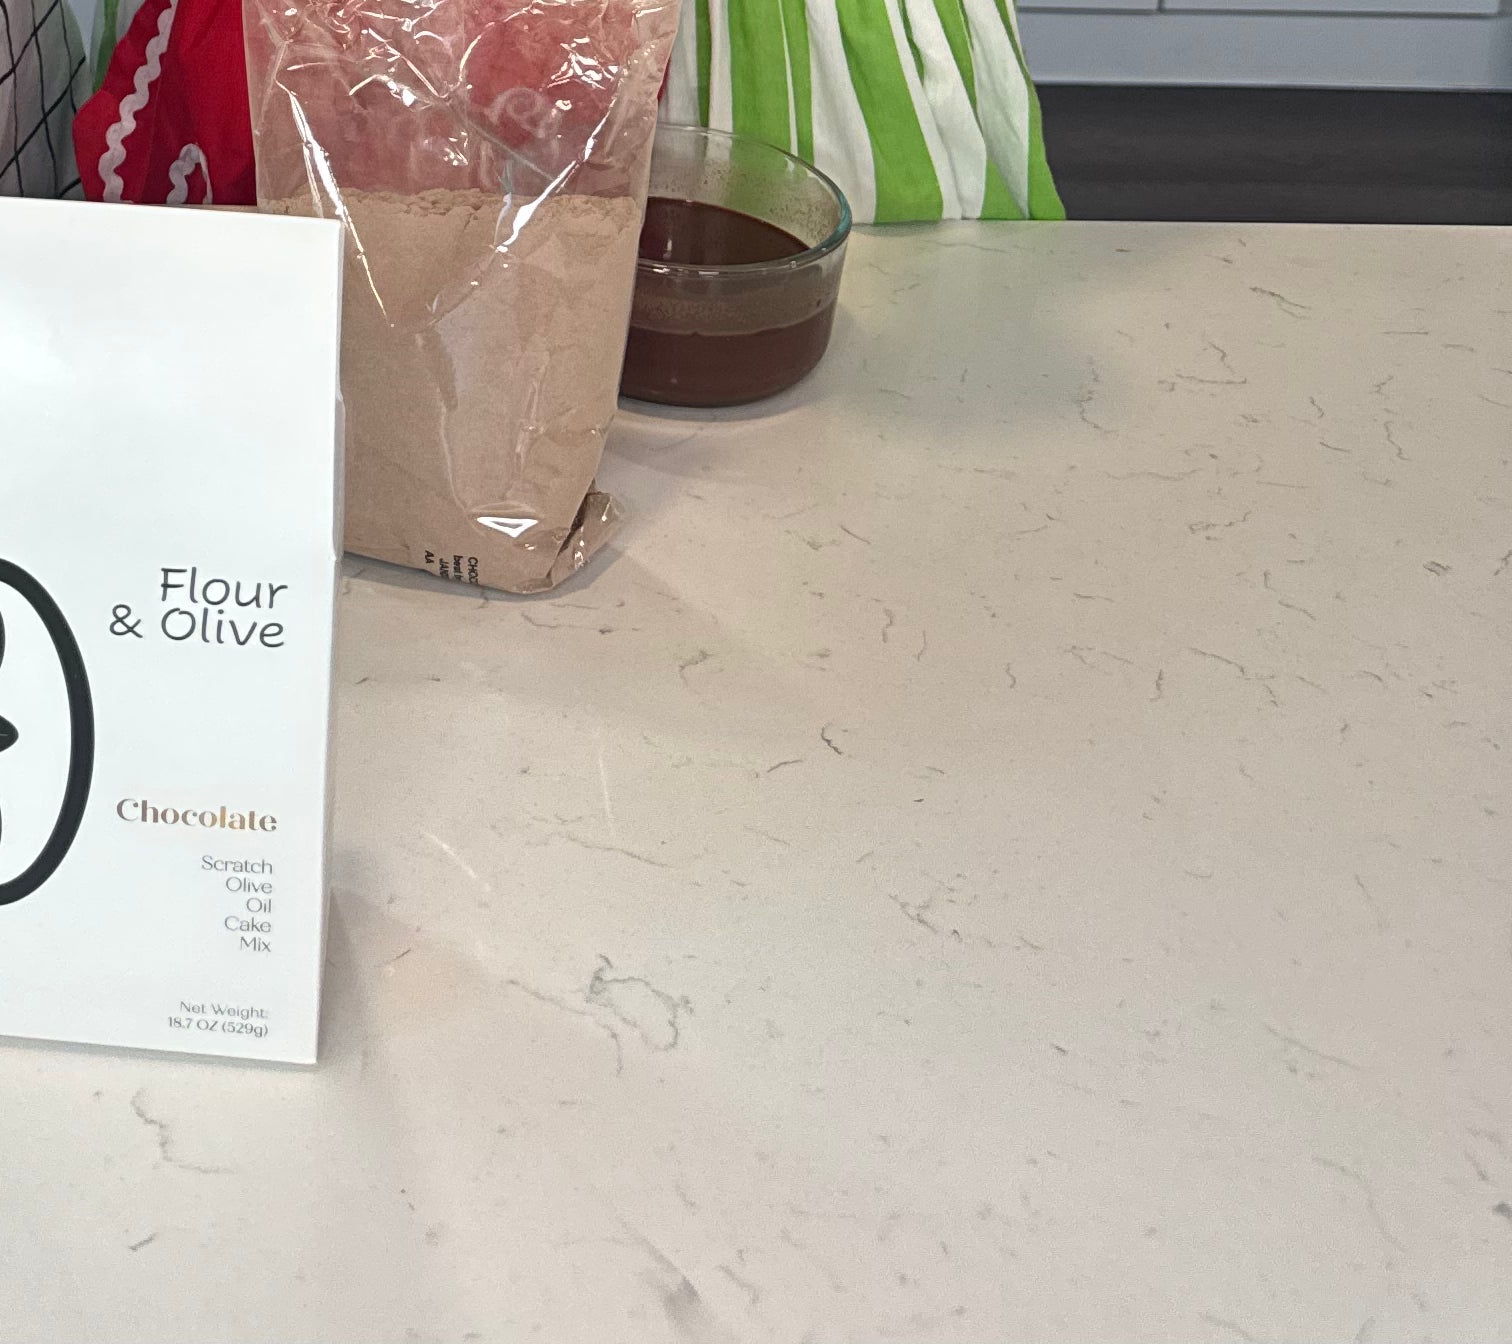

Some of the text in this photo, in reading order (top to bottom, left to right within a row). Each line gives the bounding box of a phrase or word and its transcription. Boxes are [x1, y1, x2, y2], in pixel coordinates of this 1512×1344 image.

[160, 566, 289, 609] Flour
[109, 603, 285, 648] & Olive
[116, 798, 277, 832] Chocolate
[201, 854, 273, 874] Scratch
[225, 876, 273, 894] Olive
[246, 897, 272, 913] Oil
[224, 915, 272, 933] Cake
[240, 936, 272, 952] Mix
[179, 1001, 207, 1014] Net
[168, 1016, 269, 1038] 18.7 OZ (529g)
